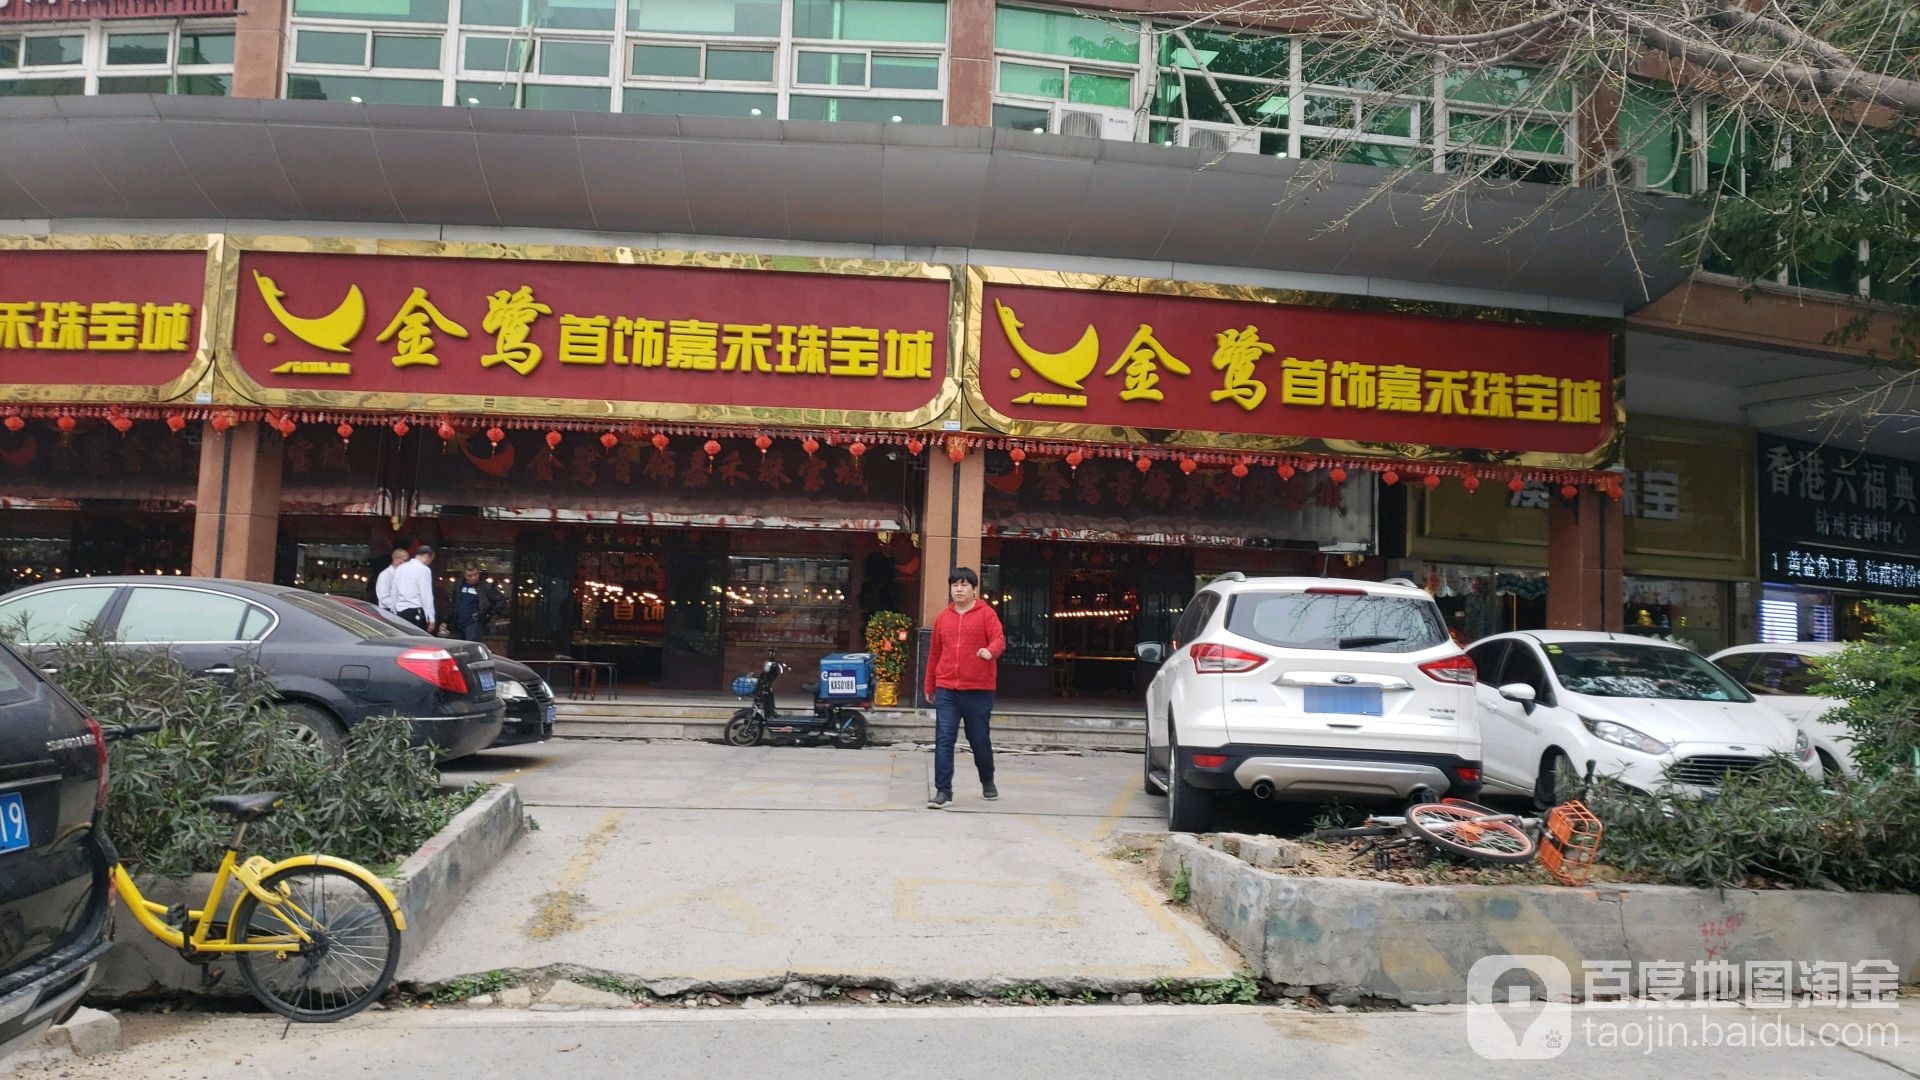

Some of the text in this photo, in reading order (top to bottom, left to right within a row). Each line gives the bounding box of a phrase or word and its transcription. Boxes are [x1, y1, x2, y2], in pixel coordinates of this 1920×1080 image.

[0, 301, 191, 351] 禾珠宝城
[377, 285, 935, 379] 金鹭 首饰嘉禾珠宝城
[1106, 323, 1602, 425] 金鹭 首饰嘉禾珠宝城
[1766, 444, 1917, 515] 香港六福典
